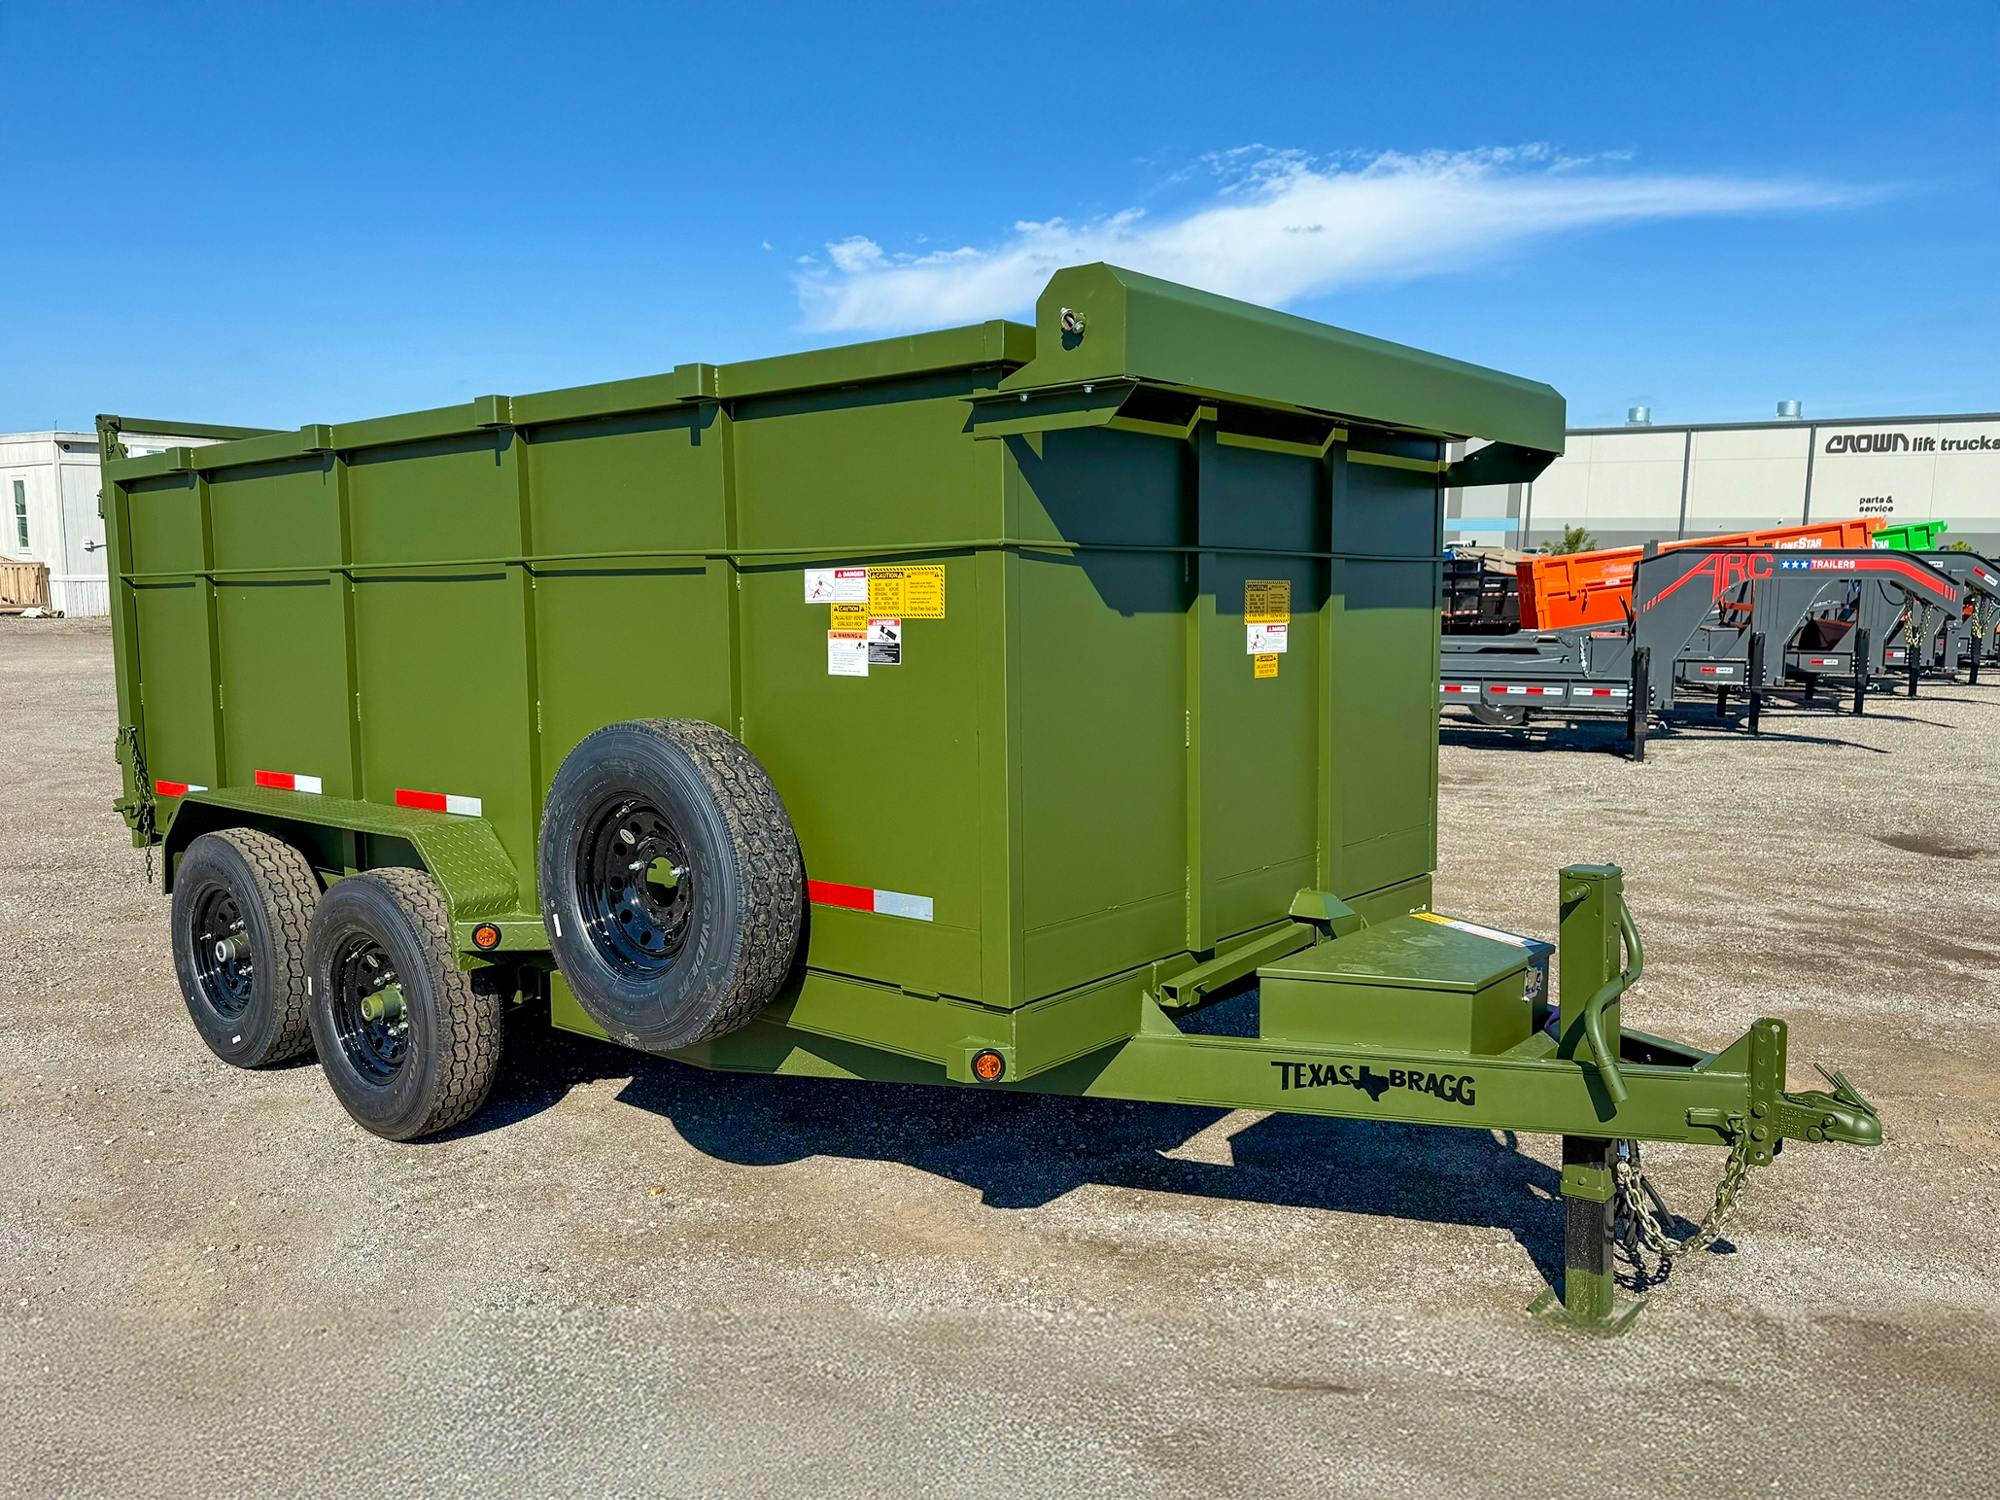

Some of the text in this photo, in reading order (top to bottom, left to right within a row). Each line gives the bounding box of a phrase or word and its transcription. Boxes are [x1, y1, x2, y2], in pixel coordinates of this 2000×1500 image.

[1825, 433, 2000, 454] CROWN lift trucks
[1858, 504, 1894, 513] service
[1859, 496, 1893, 505] parts &
[1643, 553, 1855, 612] ARC TRAILERS
[1270, 1060, 1476, 1107] TEXAS BRAGG
